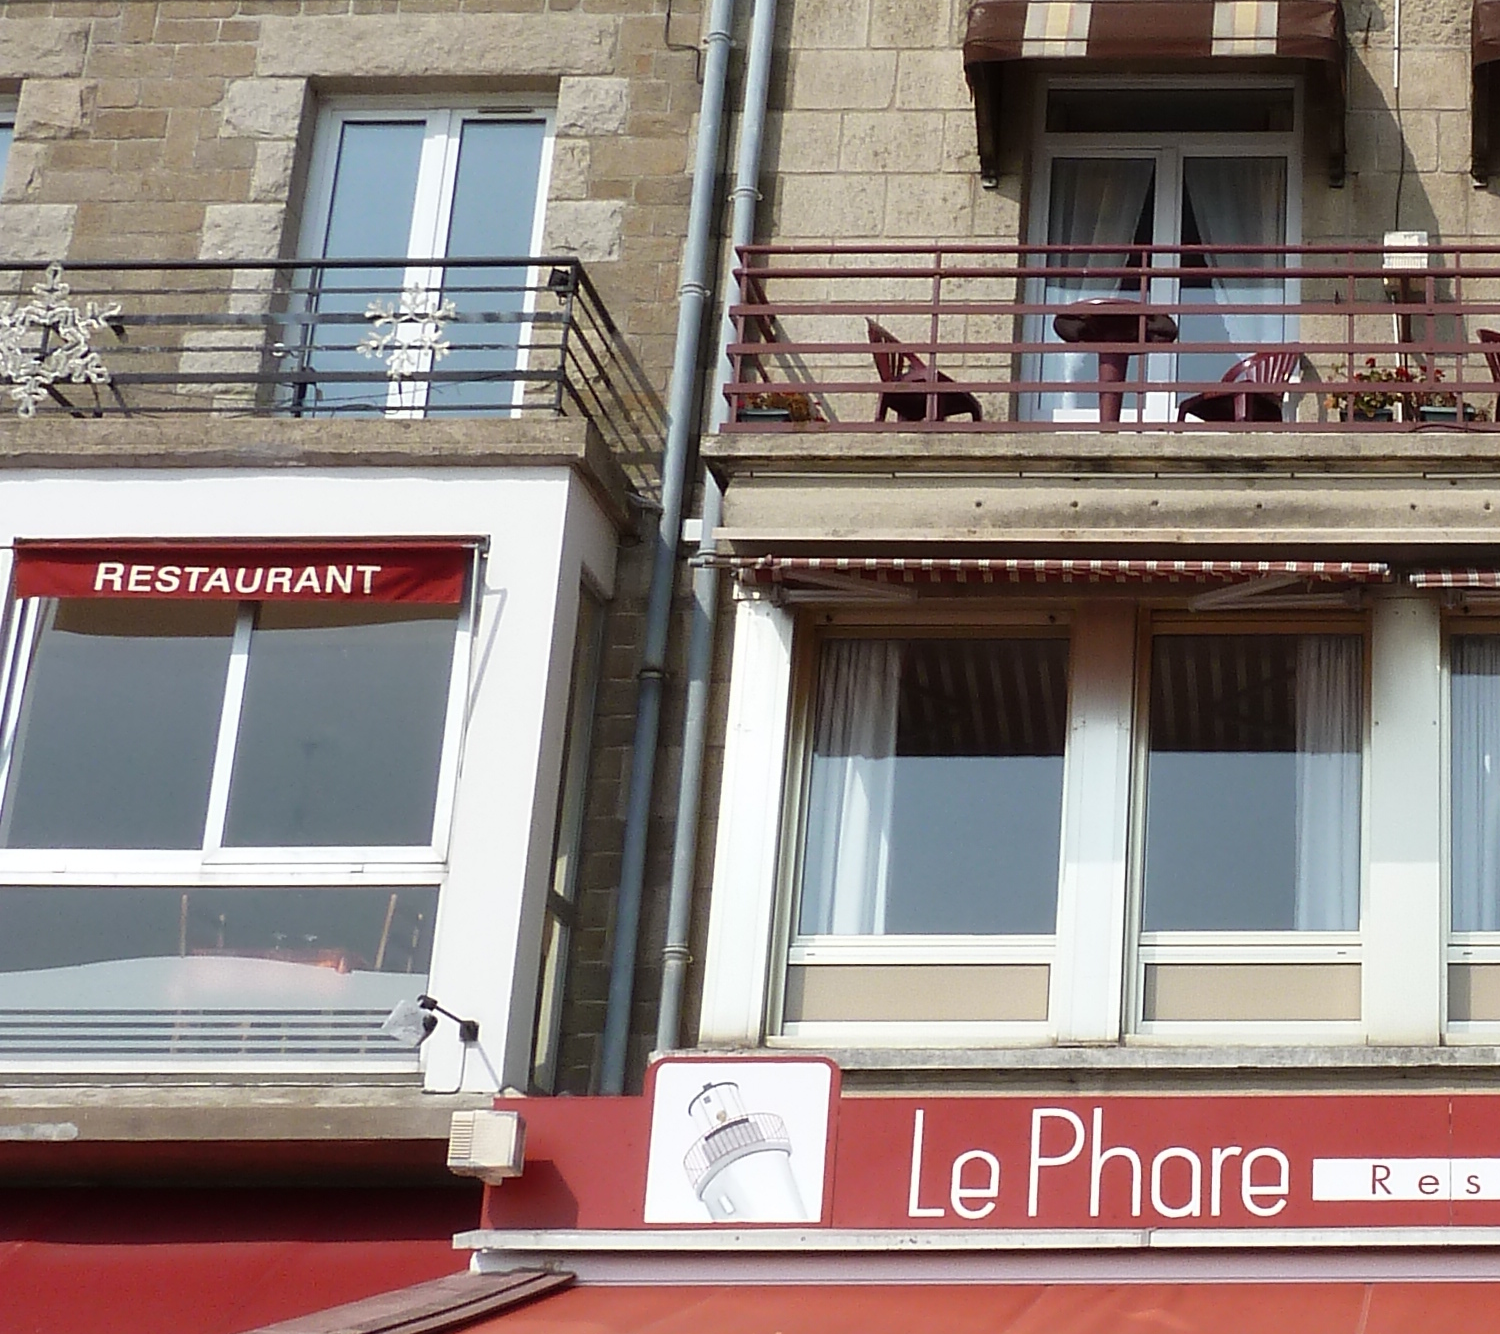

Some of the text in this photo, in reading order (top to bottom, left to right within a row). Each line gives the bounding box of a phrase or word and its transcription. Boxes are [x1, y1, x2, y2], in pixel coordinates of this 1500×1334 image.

[94, 561, 381, 597] RESTAURANT
[908, 1106, 1290, 1220] Le Phare
